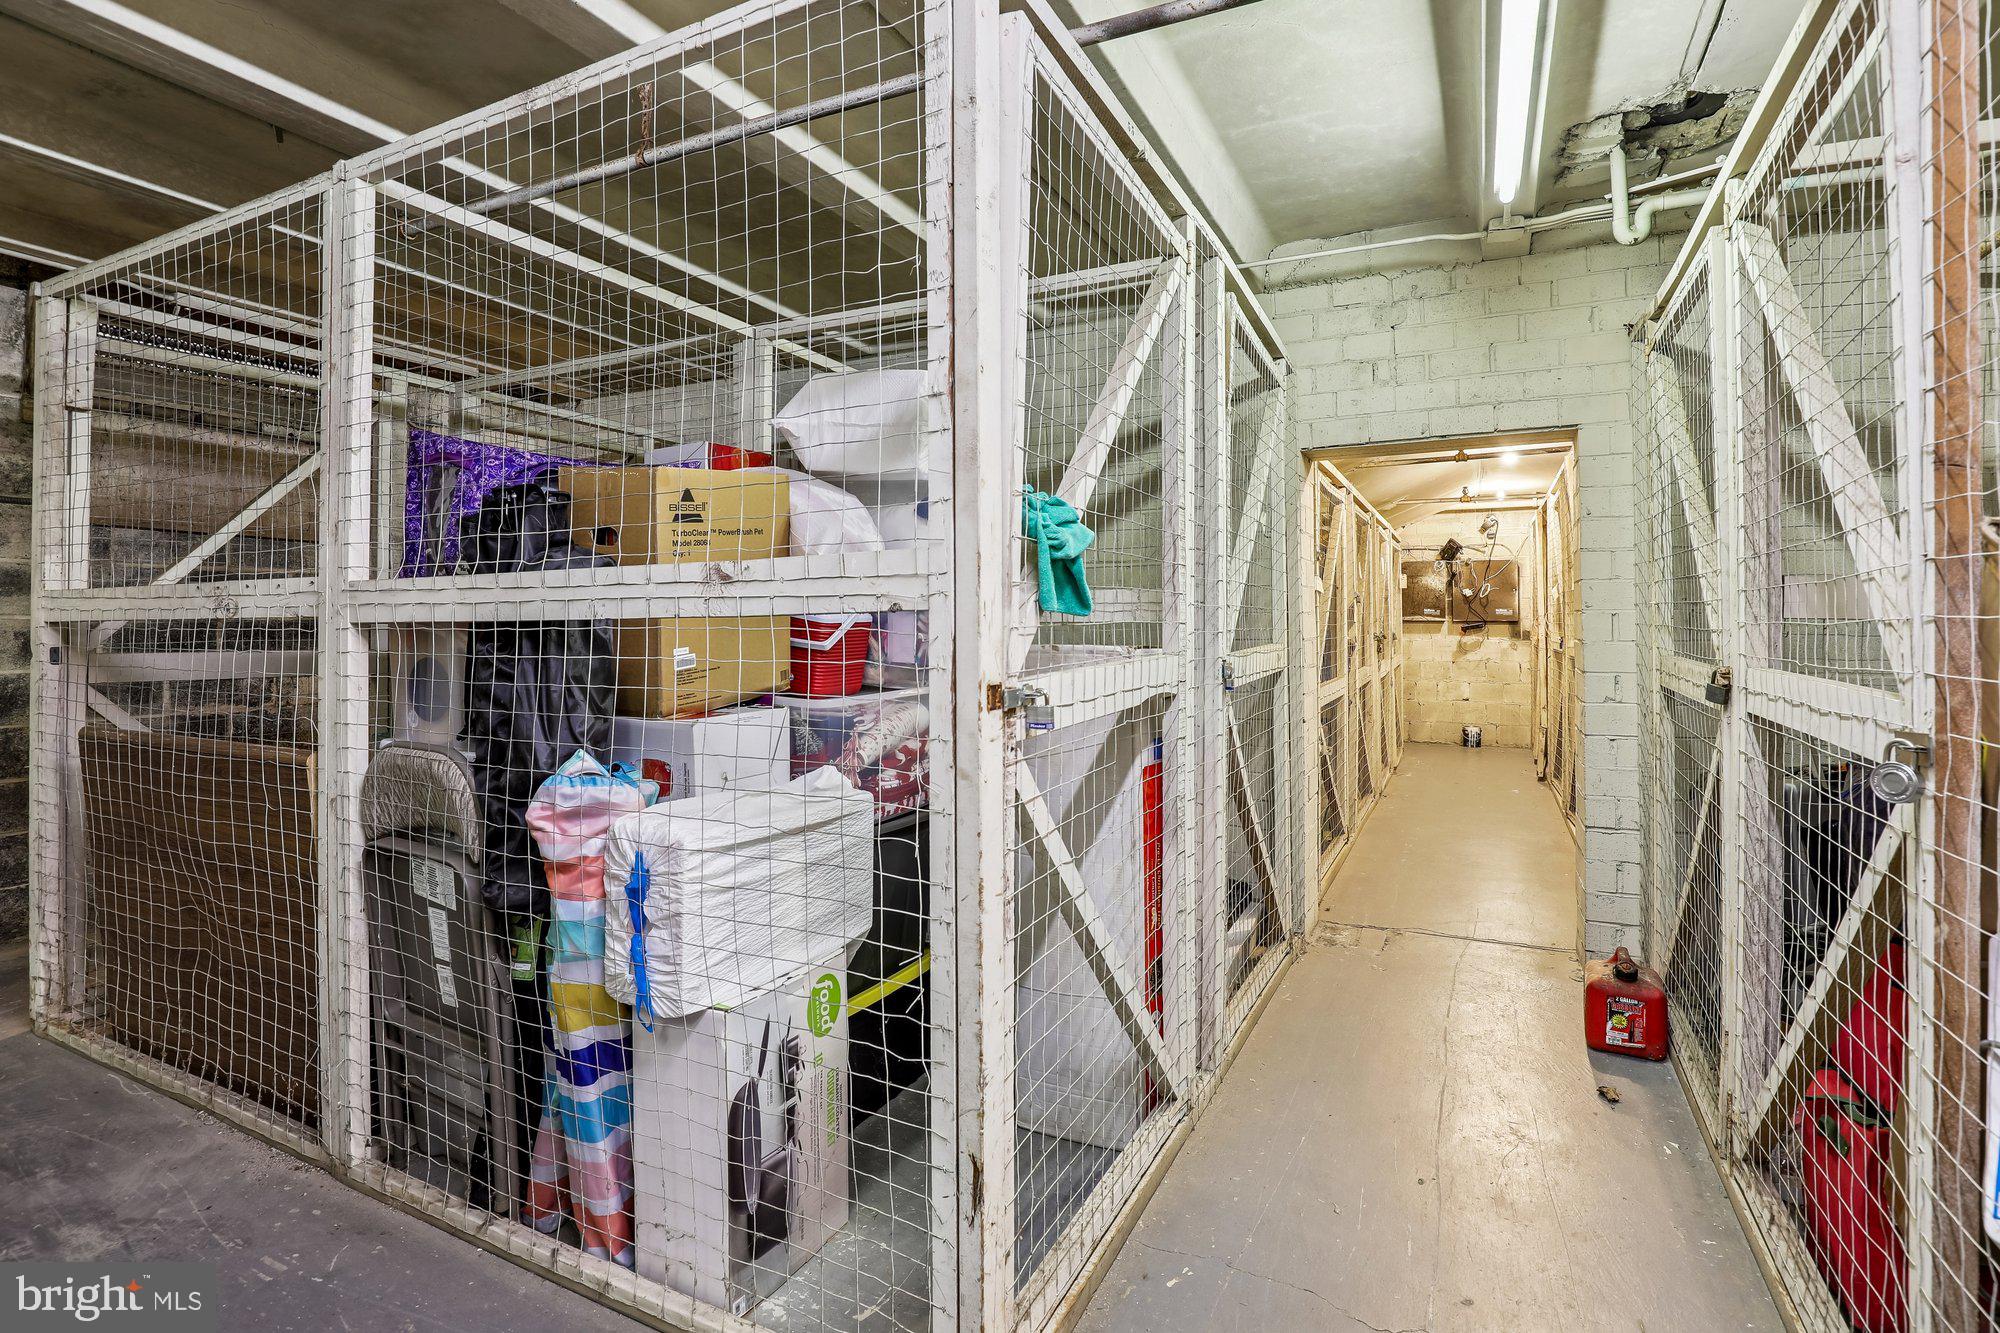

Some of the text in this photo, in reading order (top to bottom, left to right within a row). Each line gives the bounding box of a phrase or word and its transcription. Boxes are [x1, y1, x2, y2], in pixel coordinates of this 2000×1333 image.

[718, 528, 753, 536] PowerBush
[672, 539, 692, 547] Model
[812, 980, 834, 1031] food
